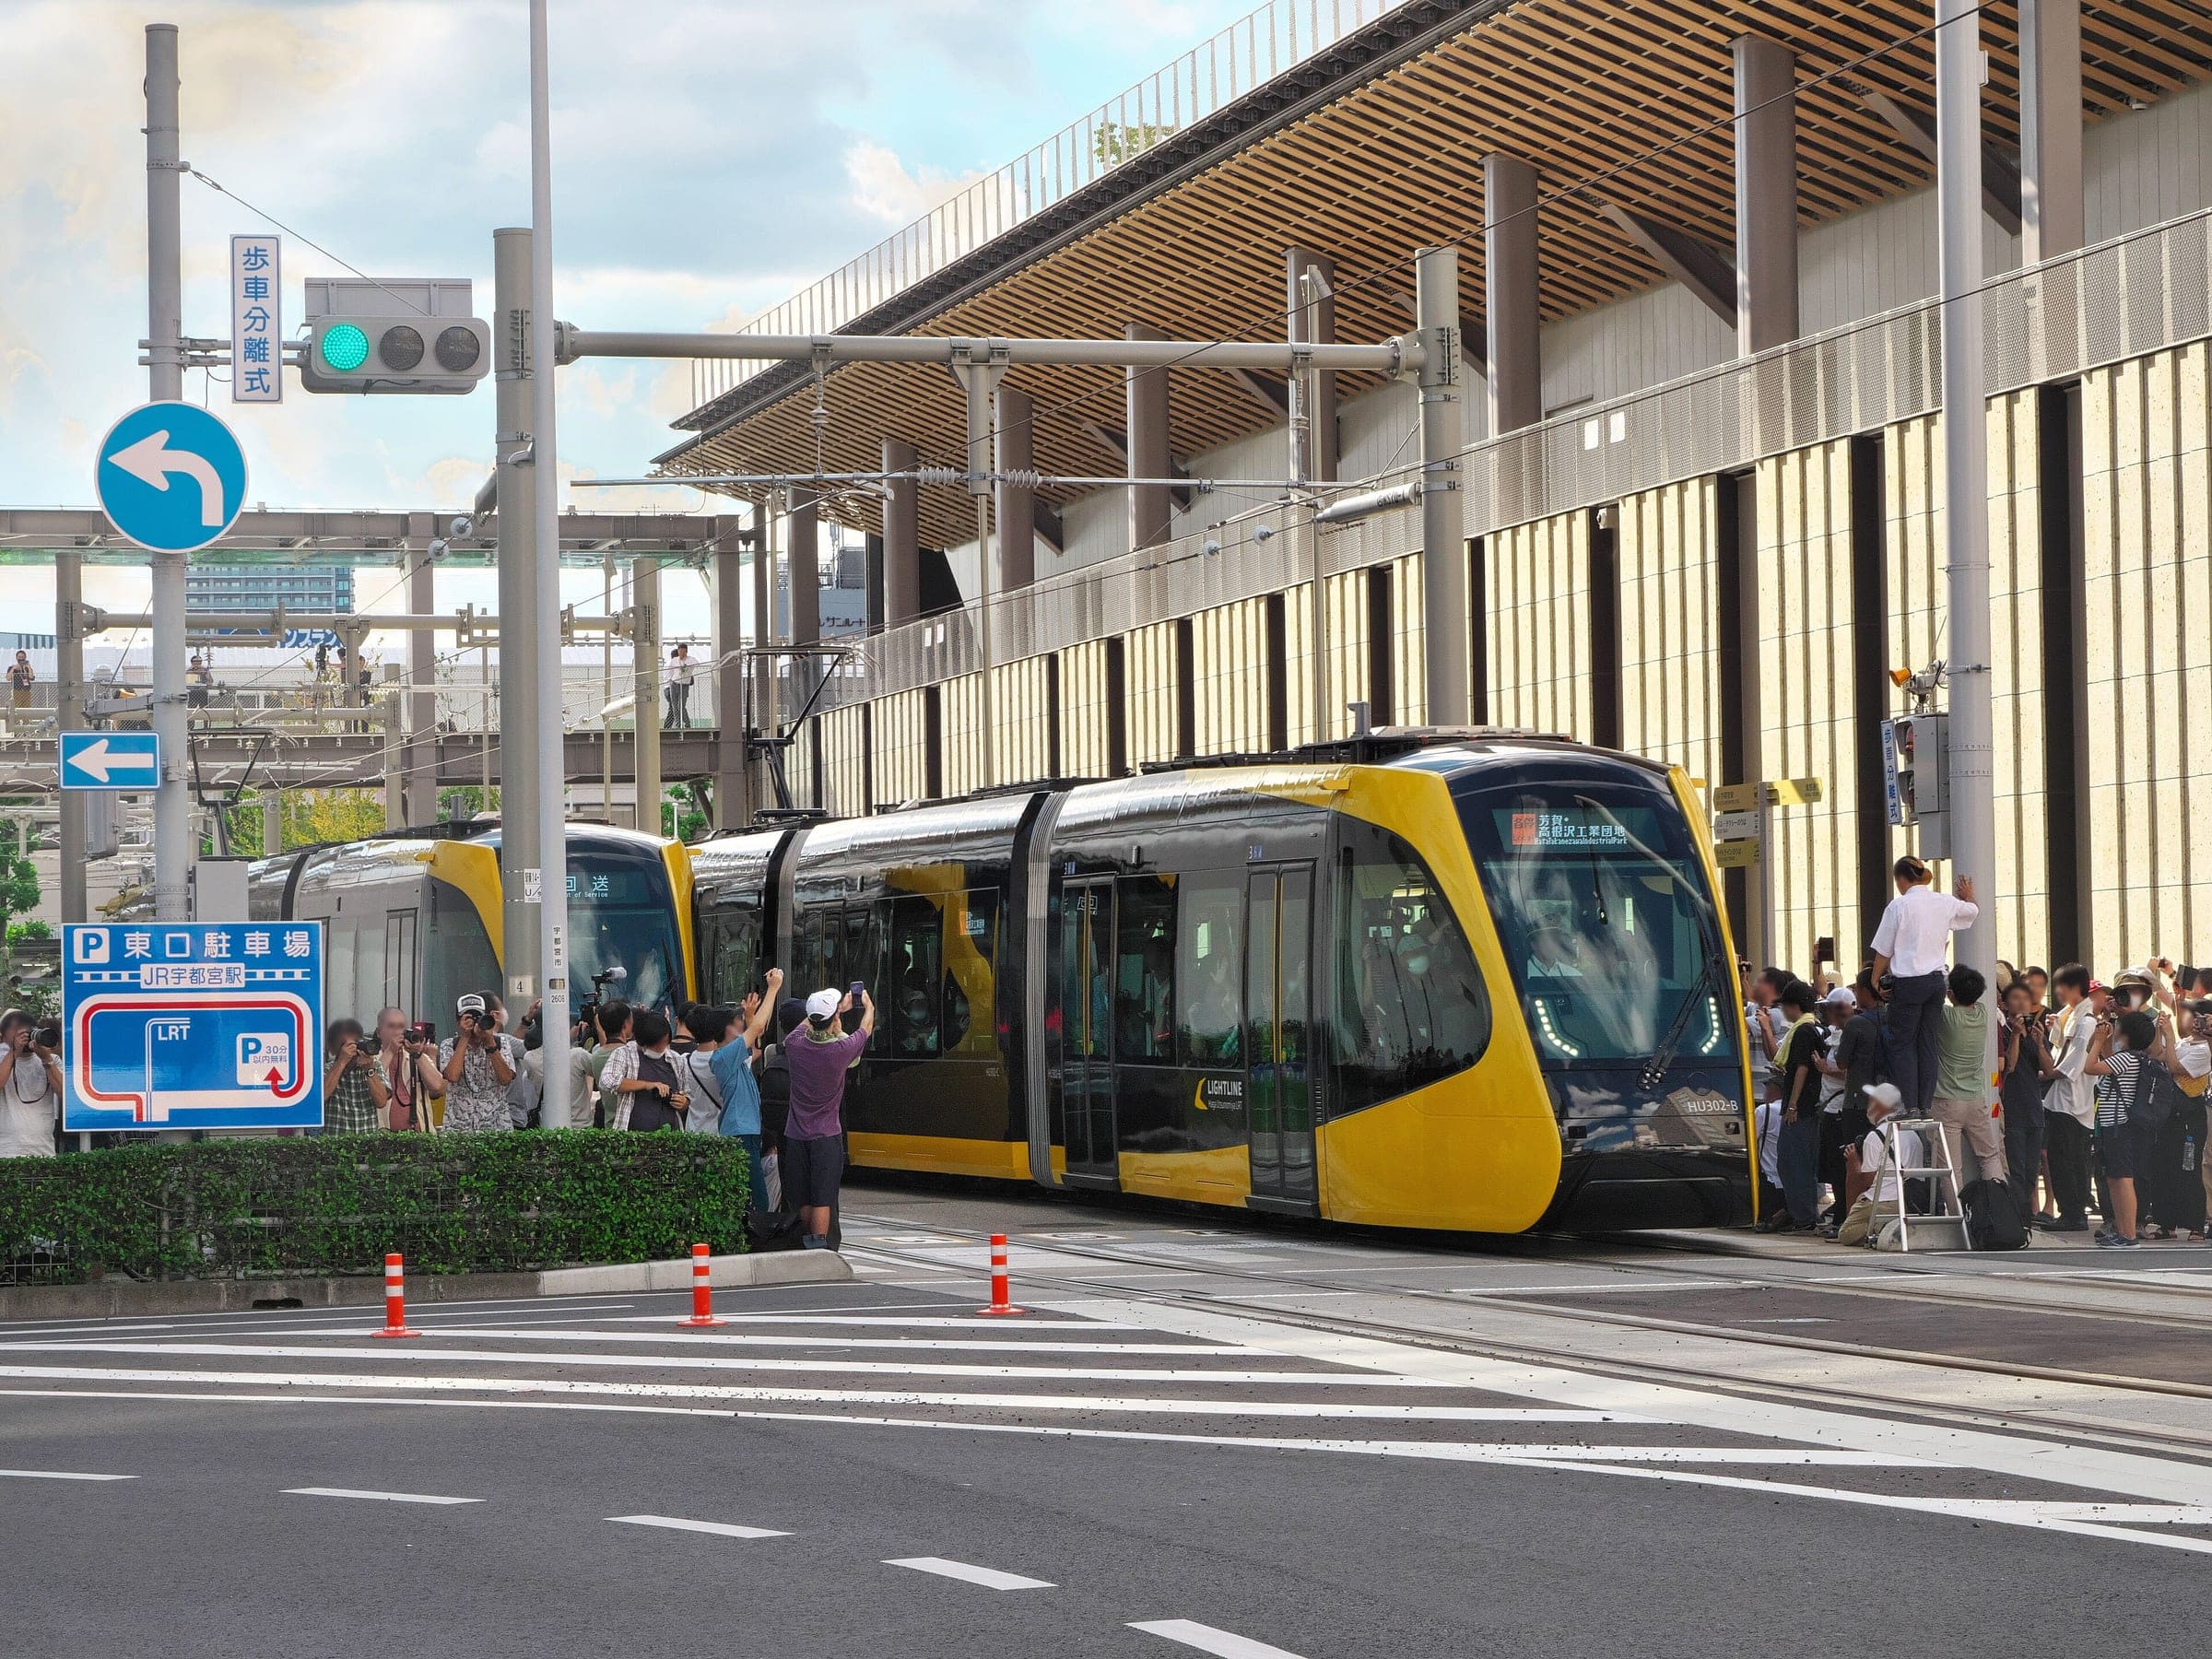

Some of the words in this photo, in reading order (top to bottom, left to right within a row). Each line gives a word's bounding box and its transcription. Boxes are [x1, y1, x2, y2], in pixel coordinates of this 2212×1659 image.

[242, 245, 271, 394] 歩車分離式
[1538, 825, 1625, 837] 高根沢工業団地
[123, 930, 312, 959] 東口駐車場
[553, 926, 562, 967] 宇都宮市
[144, 967, 242, 986] JR宇都宮駅
[516, 981, 524, 994] 4
[157, 1024, 191, 1041] LRT
[265, 1045, 288, 1054] 30分
[253, 1055, 288, 1064] 以内無料
[1207, 1080, 1242, 1096] LIGHTLINE
[1687, 1100, 1739, 1112] HU302-B
